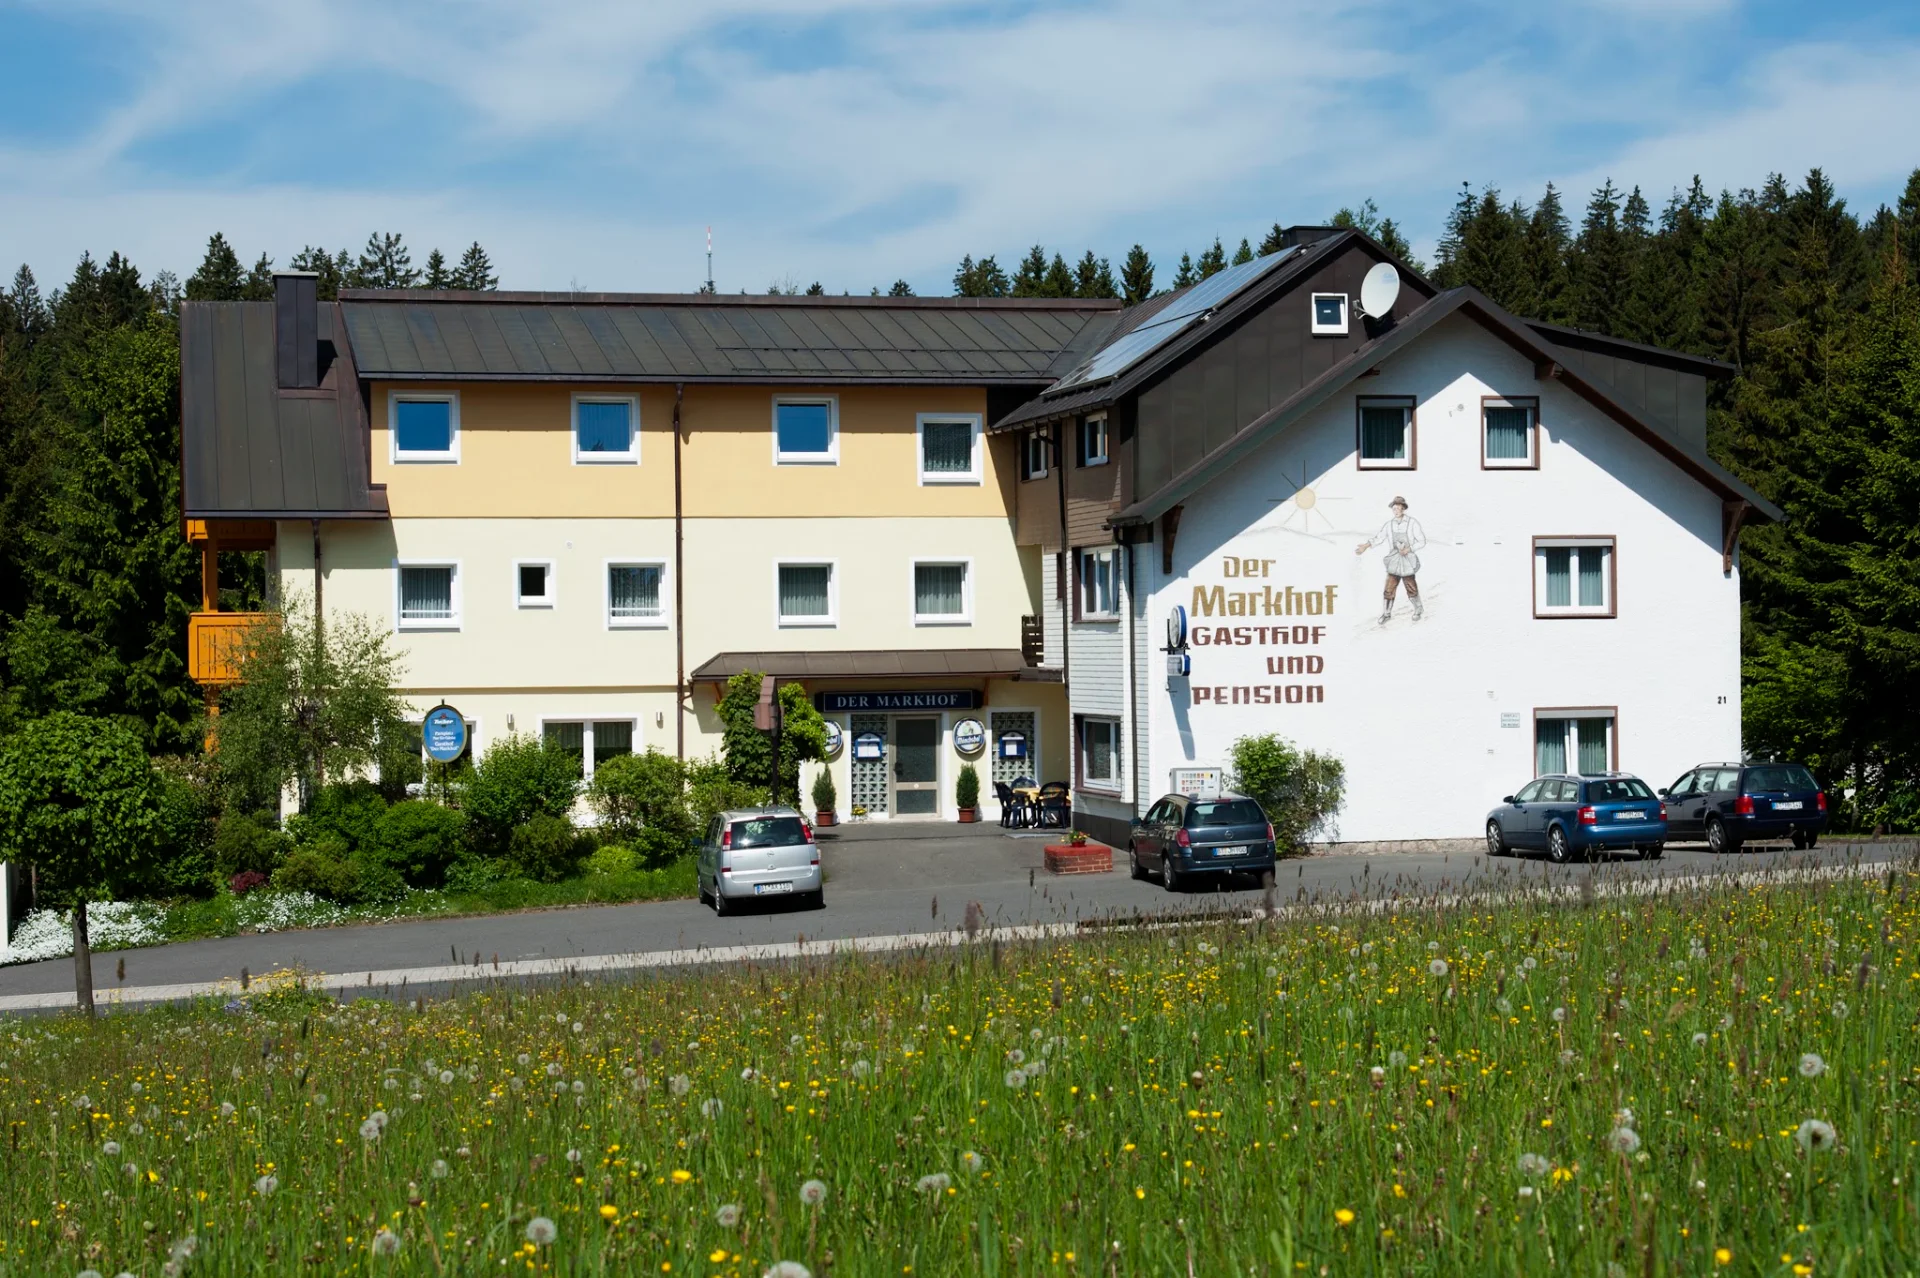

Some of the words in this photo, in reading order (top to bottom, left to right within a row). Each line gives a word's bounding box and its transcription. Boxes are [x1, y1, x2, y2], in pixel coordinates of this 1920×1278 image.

[1223, 556, 1276, 578] Der
[1191, 585, 1338, 617] Markhof
[837, 696, 869, 708] DER
[877, 694, 958, 707] MARKHOF
[1717, 696, 1727, 705] 21
